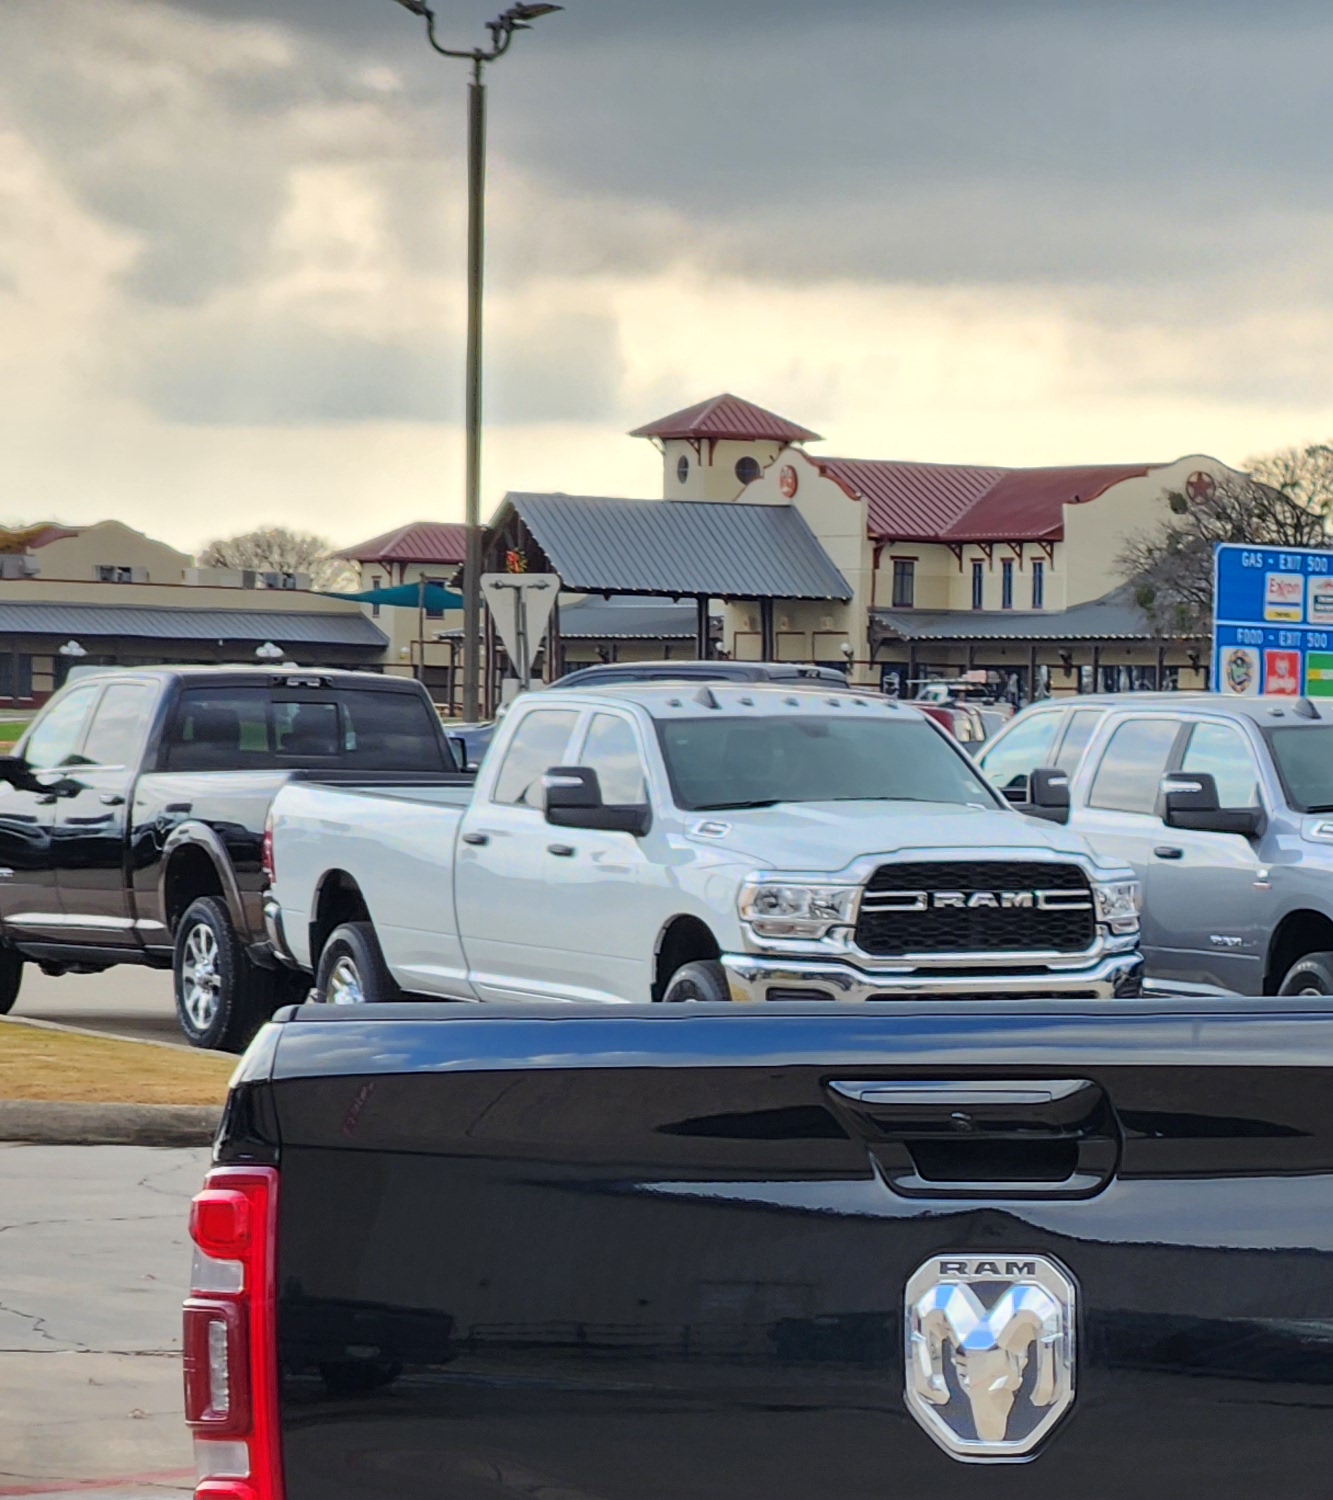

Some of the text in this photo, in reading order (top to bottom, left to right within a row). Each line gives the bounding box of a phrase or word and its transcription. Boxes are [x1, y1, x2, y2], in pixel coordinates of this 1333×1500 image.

[1242, 552, 1263, 567] GAS
[1279, 554, 1302, 570] EXIT
[1307, 556, 1328, 572] 500
[1237, 628, 1263, 644] FOOD
[1279, 631, 1302, 646] EXIT
[1307, 633, 1328, 648] 500
[933, 891, 1033, 908] RAM
[939, 1261, 1036, 1275] RAM
